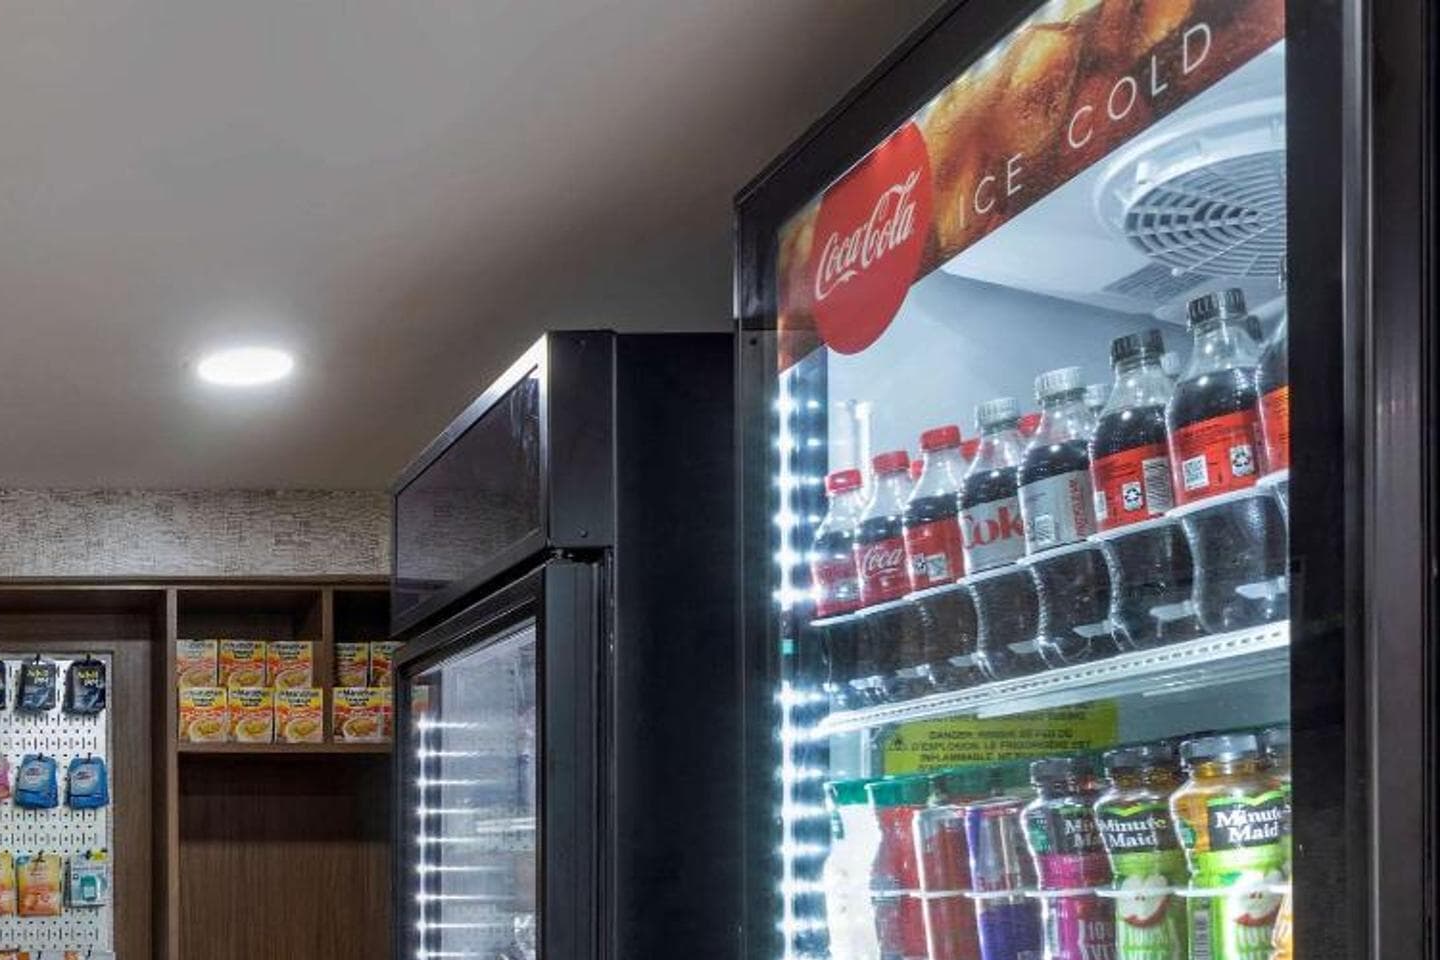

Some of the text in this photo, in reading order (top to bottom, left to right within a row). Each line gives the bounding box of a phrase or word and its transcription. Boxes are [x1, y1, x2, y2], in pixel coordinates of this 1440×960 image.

[957, 21, 1212, 230] ICE COLD
[1108, 832, 1157, 848] Maid
[1227, 821, 1279, 843] Maid
